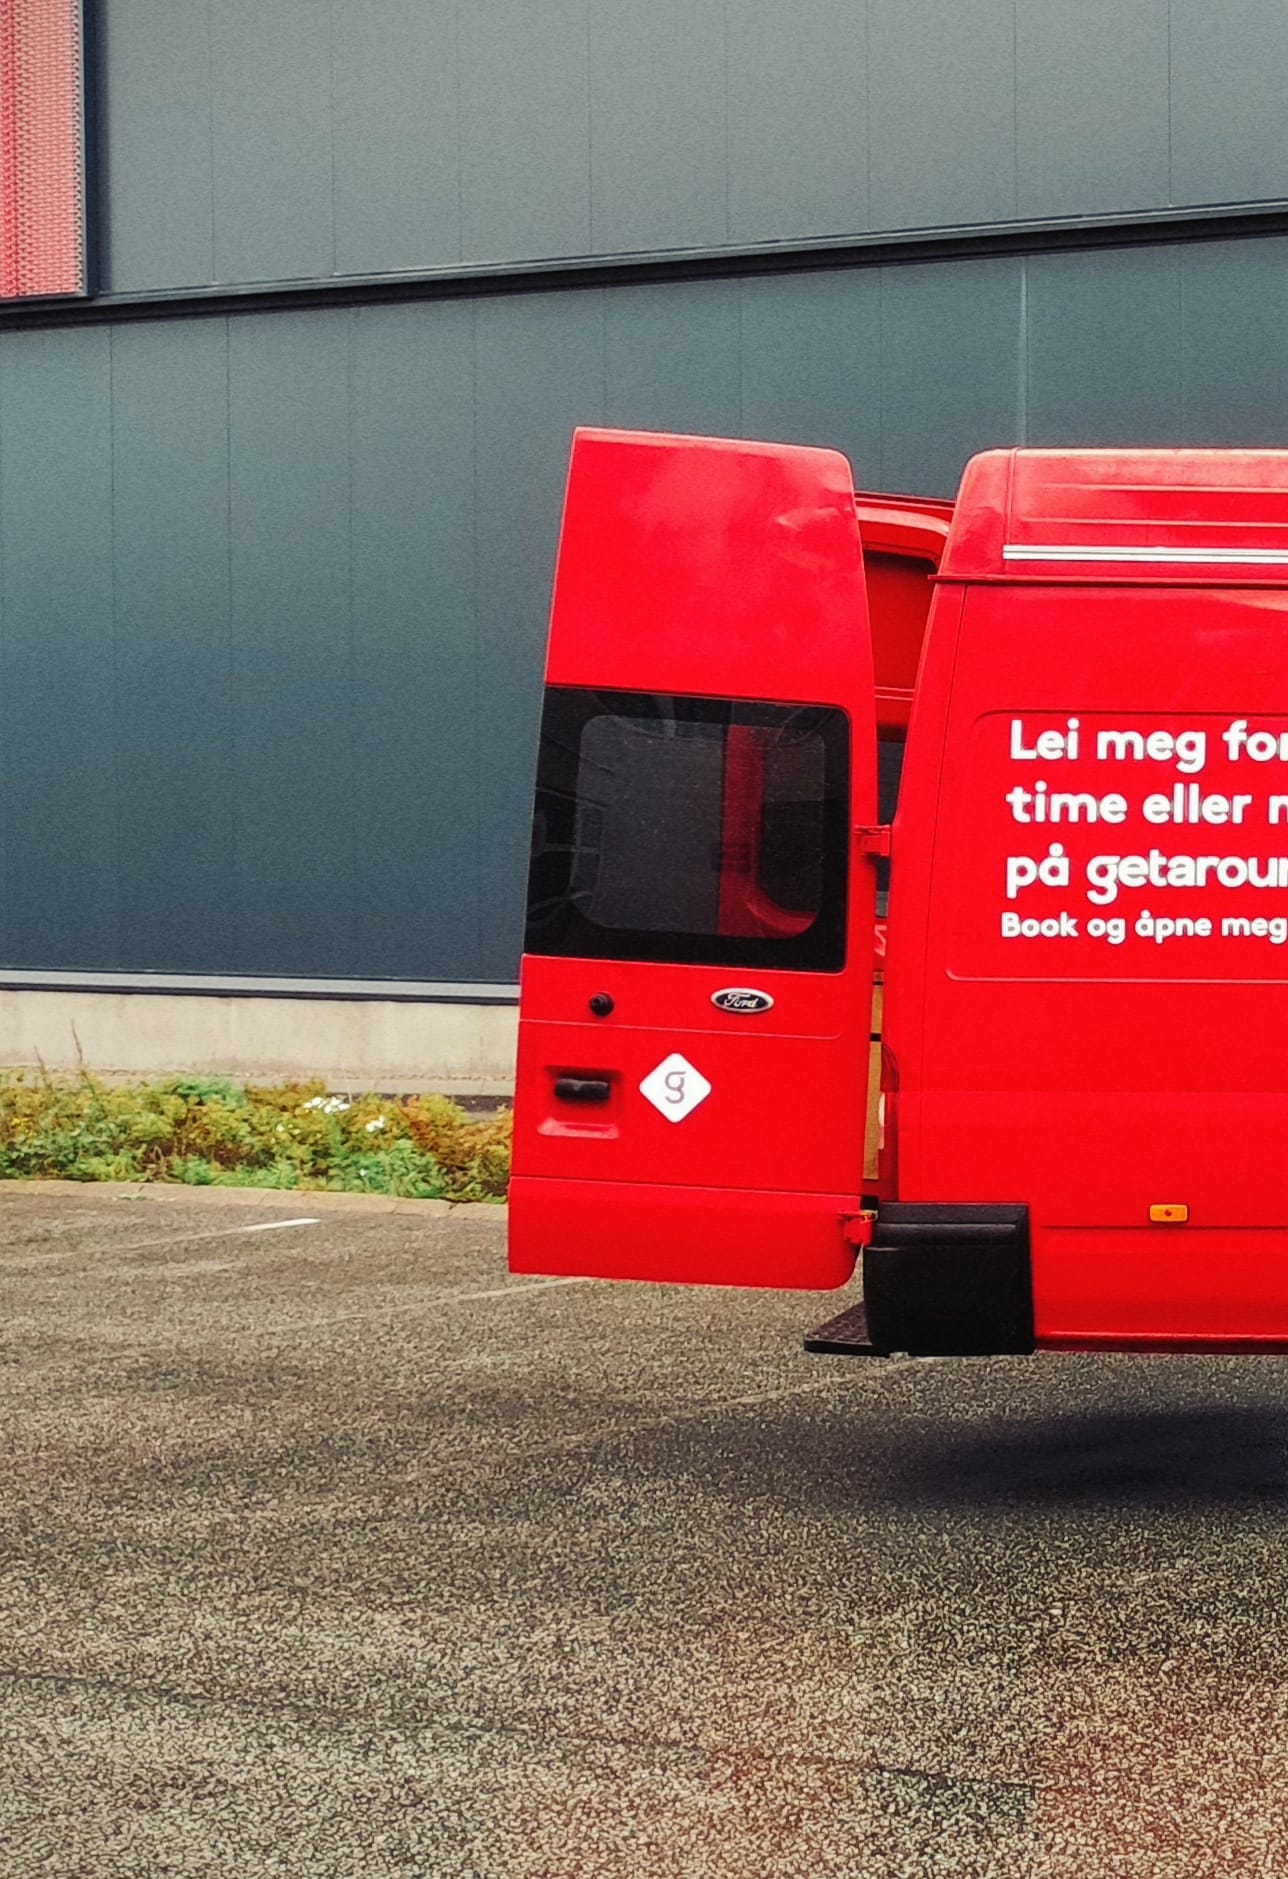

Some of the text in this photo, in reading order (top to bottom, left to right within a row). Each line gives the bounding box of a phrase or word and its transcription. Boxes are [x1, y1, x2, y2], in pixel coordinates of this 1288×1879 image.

[1010, 717, 1080, 761] Lei
[1096, 730, 1207, 774] meg
[1005, 780, 1128, 824] time
[1142, 782, 1253, 825] eller
[1006, 842, 1070, 899] på
[1001, 911, 1079, 938] Book
[1086, 917, 1126, 945] og
[1134, 909, 1213, 944] åpne
[1221, 917, 1288, 945] meg
[724, 992, 759, 1008] Ford
[664, 1071, 686, 1104] g
